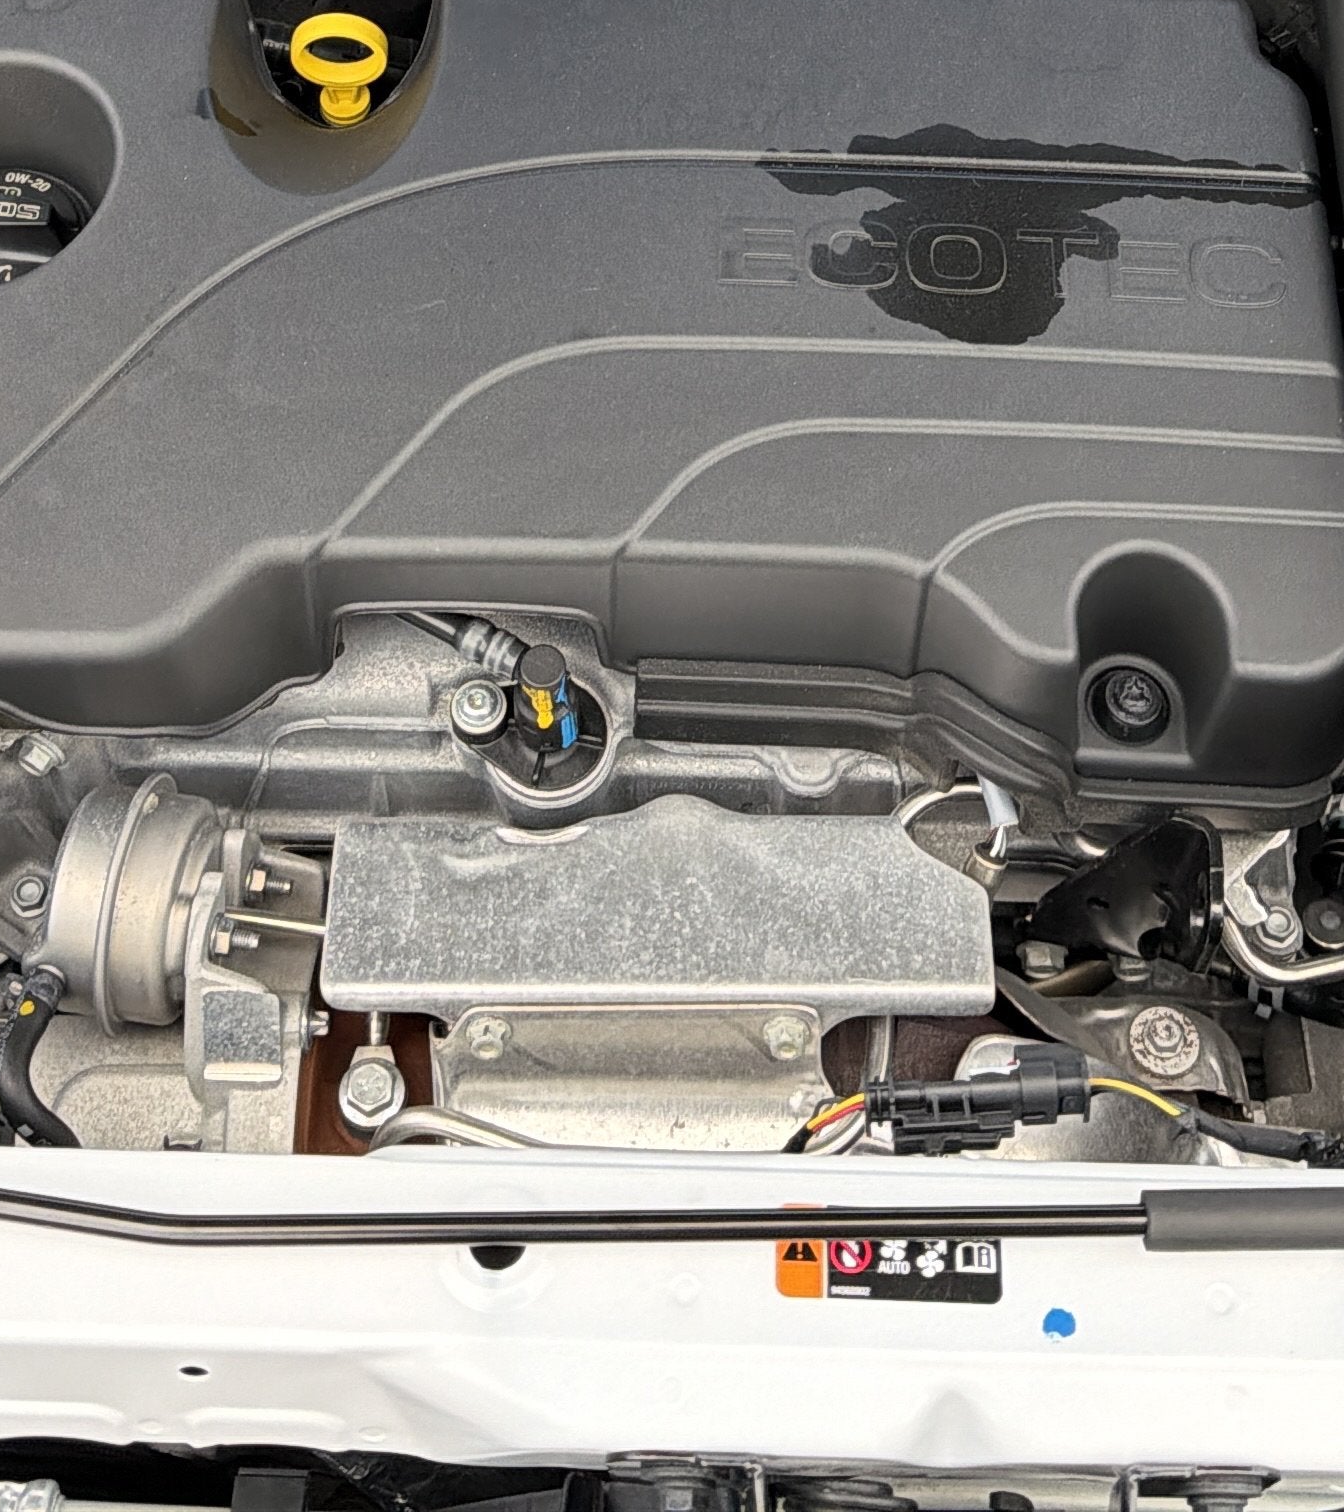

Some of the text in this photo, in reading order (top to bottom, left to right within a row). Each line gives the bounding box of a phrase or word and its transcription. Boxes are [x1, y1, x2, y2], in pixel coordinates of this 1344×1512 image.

[4, 172, 52, 193] 0W-20
[716, 216, 1290, 310] ECOTEC
[877, 1260, 911, 1275] AUTO
